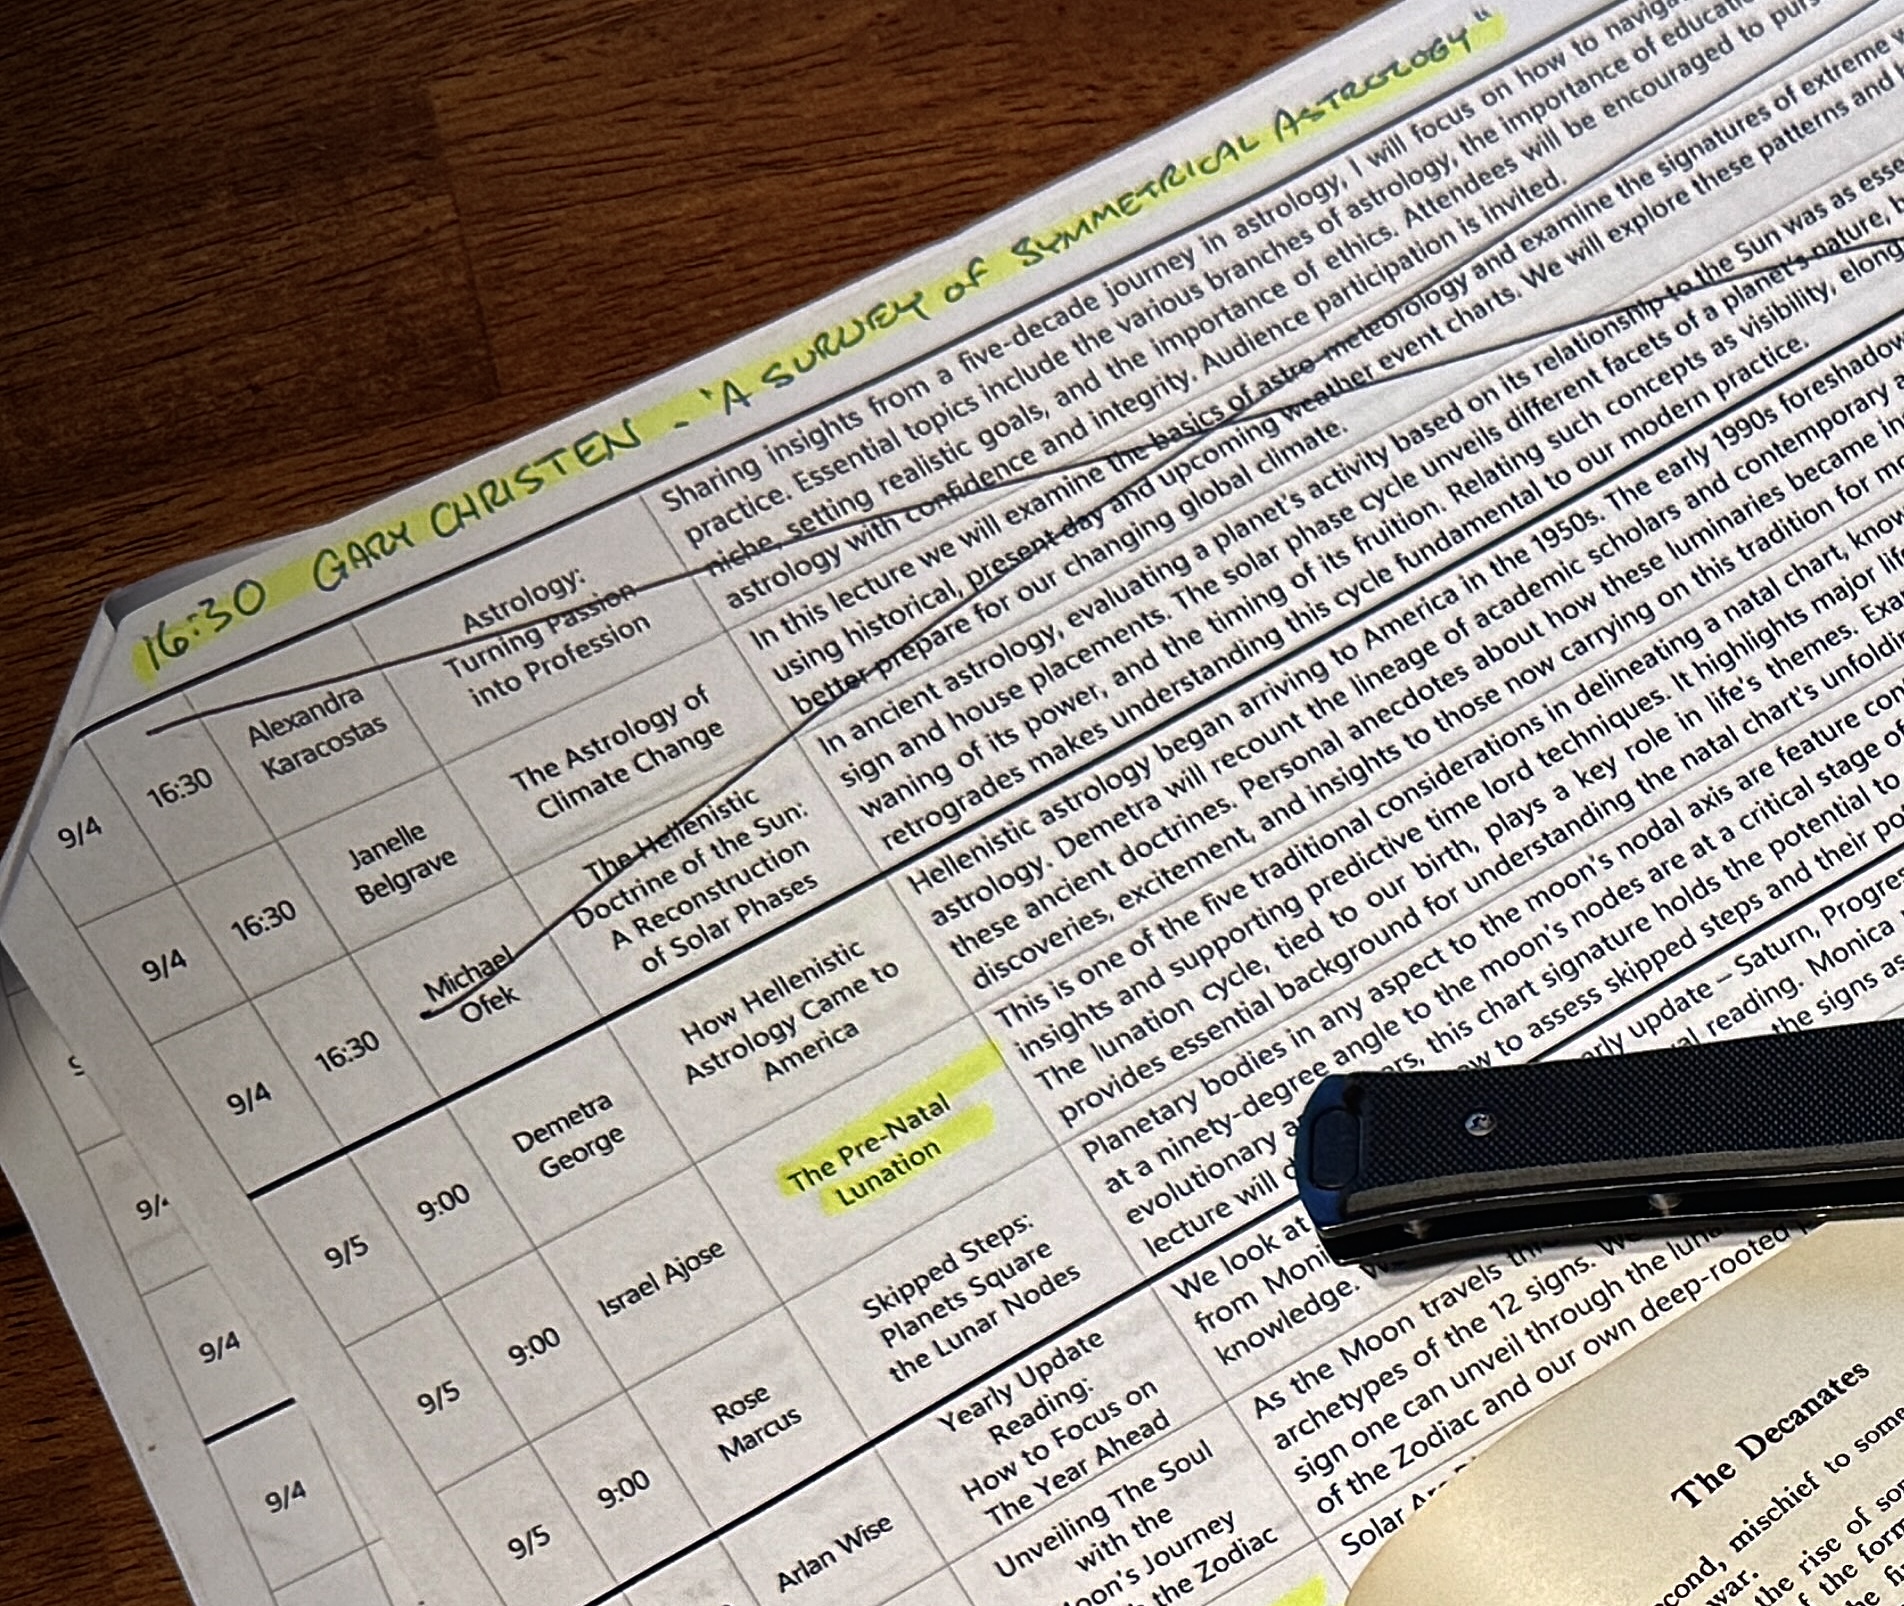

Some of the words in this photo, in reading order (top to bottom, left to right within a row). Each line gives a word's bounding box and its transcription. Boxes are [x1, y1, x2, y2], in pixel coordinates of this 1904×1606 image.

[660, 458, 763, 512] Sharing
[762, 410, 864, 465] insights
[866, 379, 931, 417] from
[935, 367, 954, 385] a
[956, 294, 1101, 373] five-decade
[1101, 246, 1195, 308] journey
[1197, 232, 1228, 255] in
[1232, 173, 1340, 240] astrology,
[145, 578, 267, 671] 16:30
[313, 521, 415, 592] GARY
[430, 417, 642, 538] CHRISTEN
[760, 289, 932, 389] SURVEY
[1009, 135, 1261, 268] SYMMETRICAL
[248, 687, 365, 748] Alexandra
[508, 762, 562, 791] The
[565, 703, 678, 770] Astrology
[682, 683, 709, 711] of
[260, 717, 388, 780] Karacostas
[536, 767, 631, 819] Climate
[632, 721, 725, 773] Change
[146, 767, 213, 808] 16:30
[57, 815, 102, 849] 9/4
[348, 825, 428, 871] Janelle
[355, 850, 458, 906] Belgrave
[315, 1030, 380, 1072] 16:30
[763, 1022, 860, 1082] America
[226, 1081, 272, 1116] 9/4
[511, 1094, 614, 1153] Demetra
[538, 1127, 626, 1179] George
[786, 1161, 837, 1192] The
[836, 1091, 951, 1167] Pre-Natal
[416, 1184, 470, 1223] 9:00
[834, 1141, 942, 1207] Lunation
[324, 1234, 369, 1269] 9/5
[597, 1271, 661, 1318] Israel
[663, 1242, 726, 1285] Ajose
[862, 1251, 960, 1320] Skipped
[959, 1214, 1034, 1263] Steps:
[198, 1330, 241, 1364] 9/4
[711, 1387, 771, 1425] Rose
[717, 1408, 802, 1463] Marcus
[1670, 1462, 1736, 1509] The
[1734, 1363, 1870, 1461] Decanates
[1729, 1470, 1821, 1553] mischief
[1823, 1453, 1851, 1474] to
[777, 1550, 837, 1594] Arlan
[833, 1516, 894, 1554] Wise
